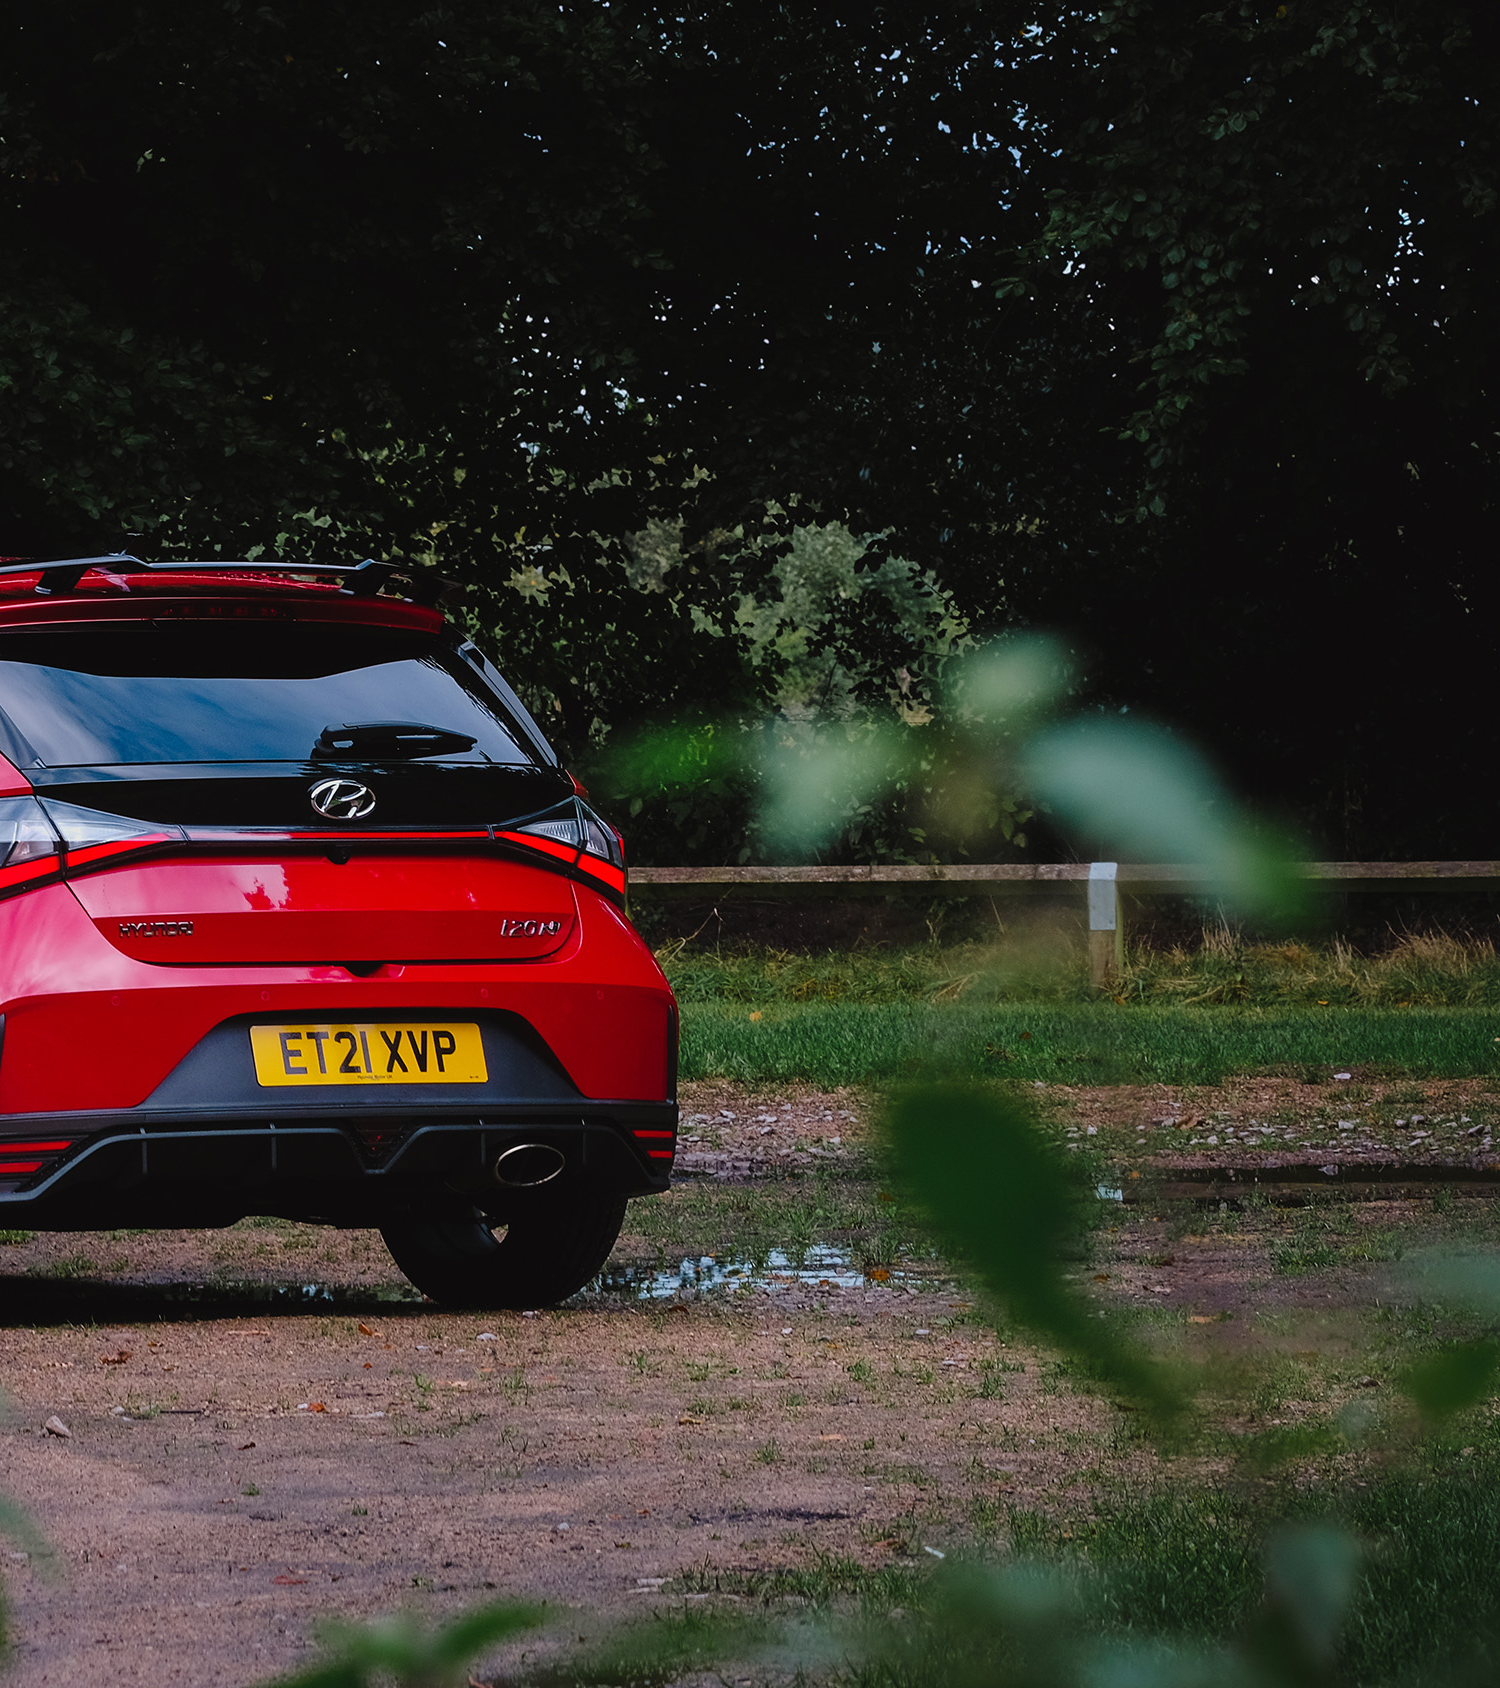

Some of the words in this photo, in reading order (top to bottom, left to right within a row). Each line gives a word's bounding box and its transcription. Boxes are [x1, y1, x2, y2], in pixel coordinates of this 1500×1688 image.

[119, 921, 193, 938] HYUNDAI
[279, 1031, 373, 1075] ET21
[380, 1030, 456, 1073] XVP
